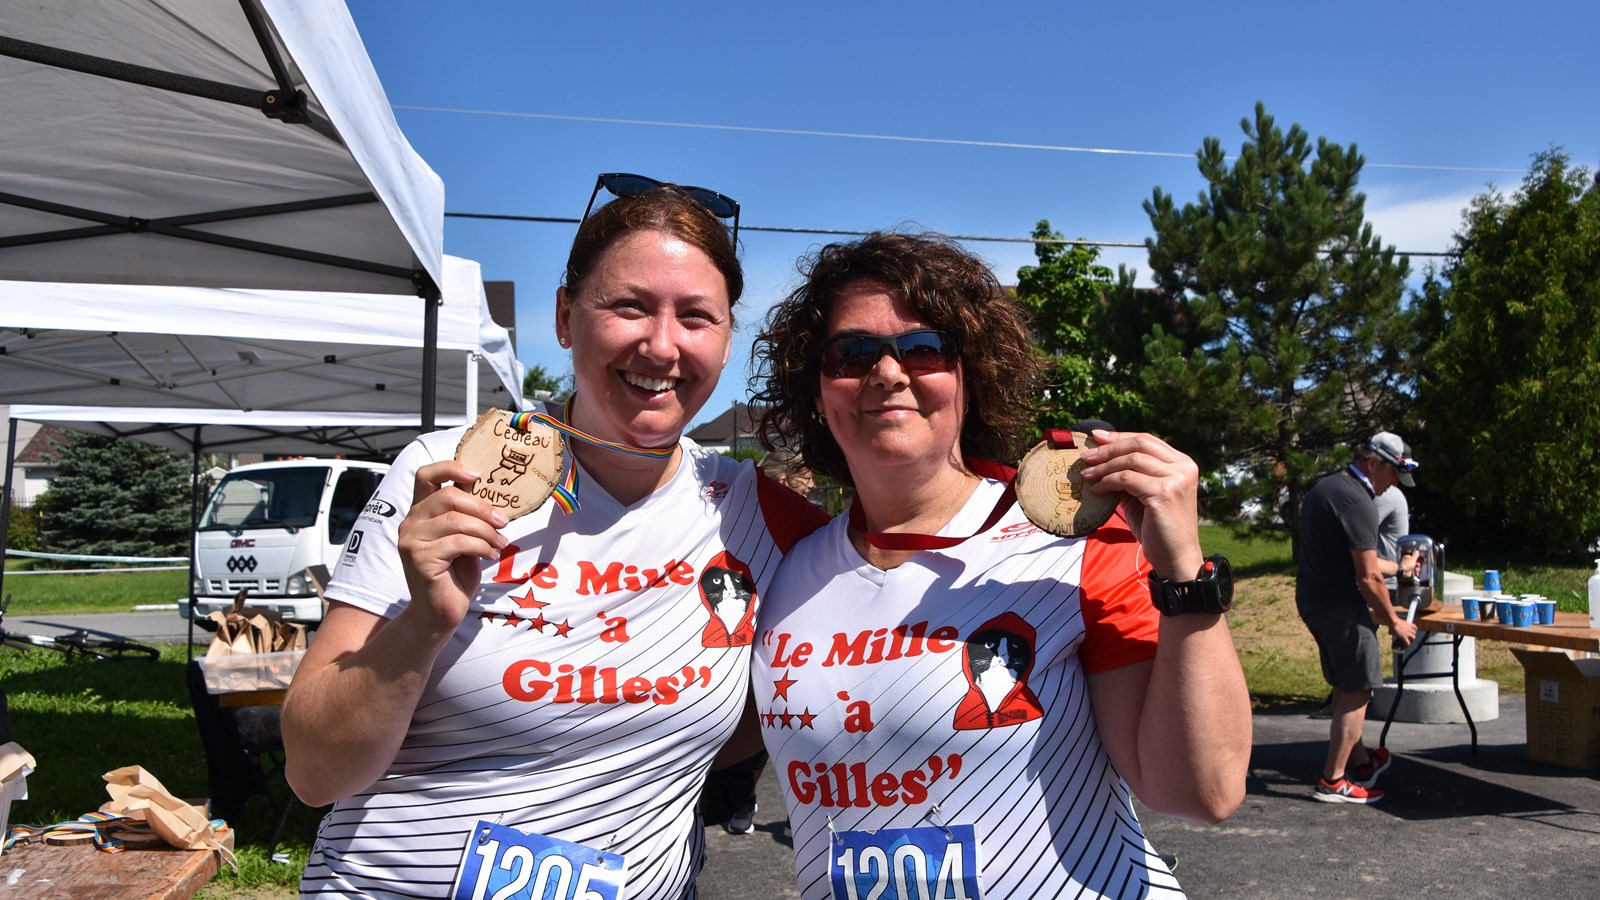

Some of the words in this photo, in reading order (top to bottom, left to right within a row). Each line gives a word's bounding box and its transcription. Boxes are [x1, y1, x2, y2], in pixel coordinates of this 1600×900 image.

[471, 477, 521, 509] Course
[230, 539, 256, 548] GMC
[492, 544, 559, 589] Le
[822, 620, 959, 667] Mille
[836, 690, 874, 733] à
[837, 842, 973, 900] 1204
